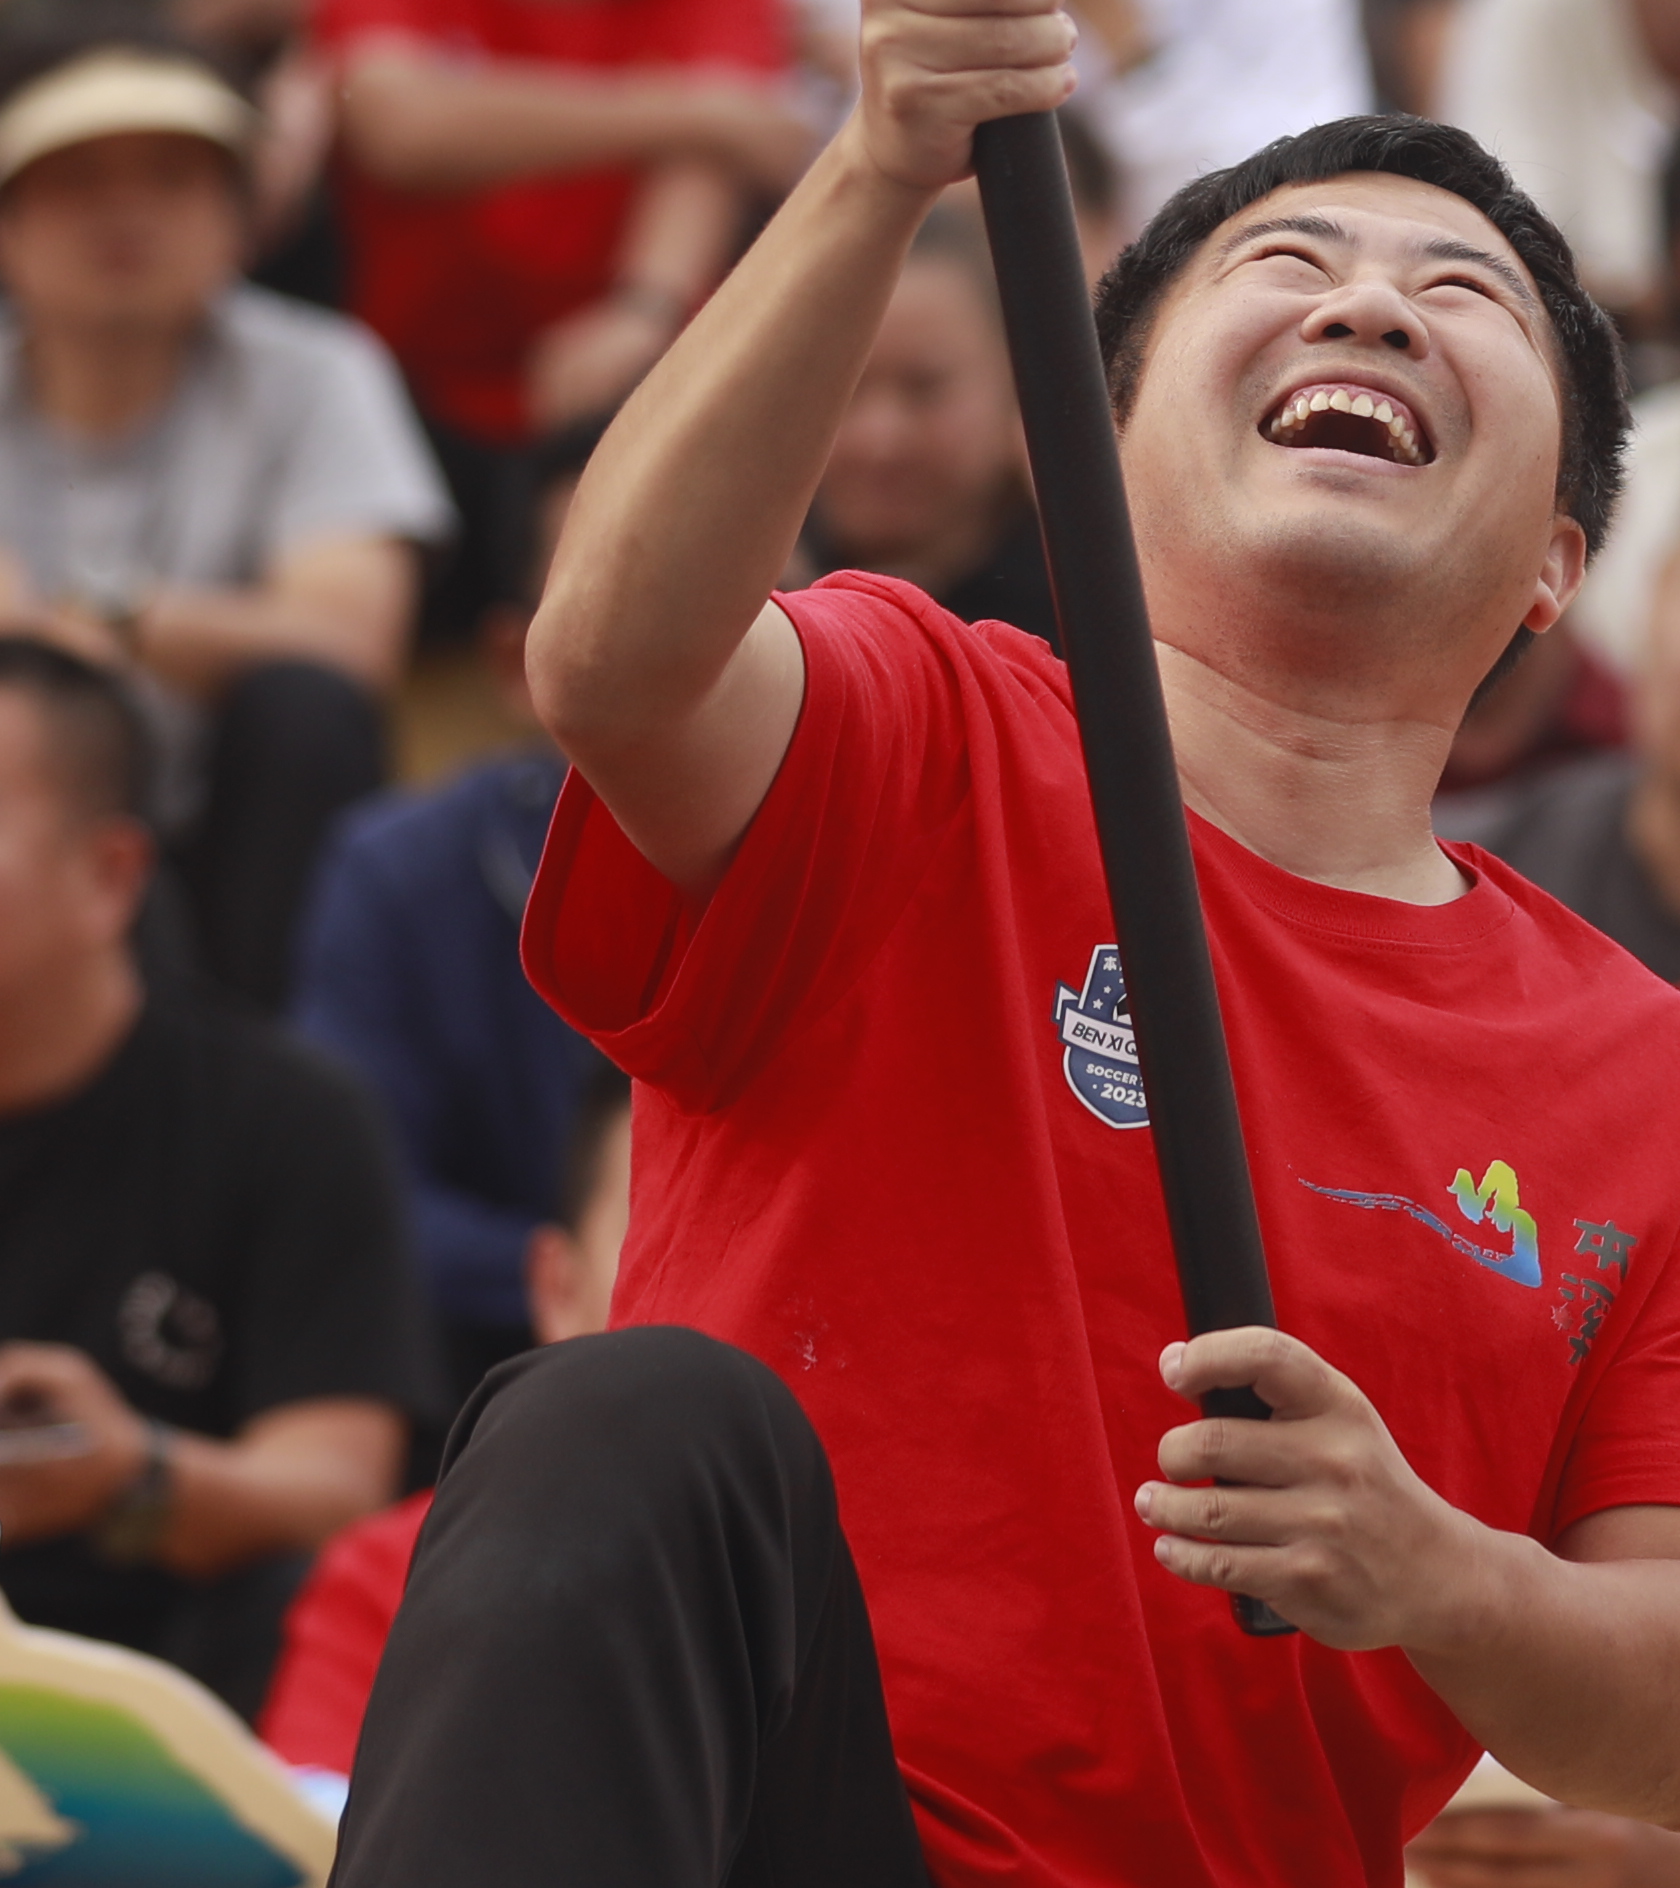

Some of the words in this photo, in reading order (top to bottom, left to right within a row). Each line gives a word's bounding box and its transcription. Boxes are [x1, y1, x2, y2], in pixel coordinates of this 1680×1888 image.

[1071, 1021, 1107, 1047] BEN
[1107, 1033, 1123, 1052] XI
[1086, 1063, 1138, 1086] SOCCER
[1100, 1083, 1147, 1108] 2023
